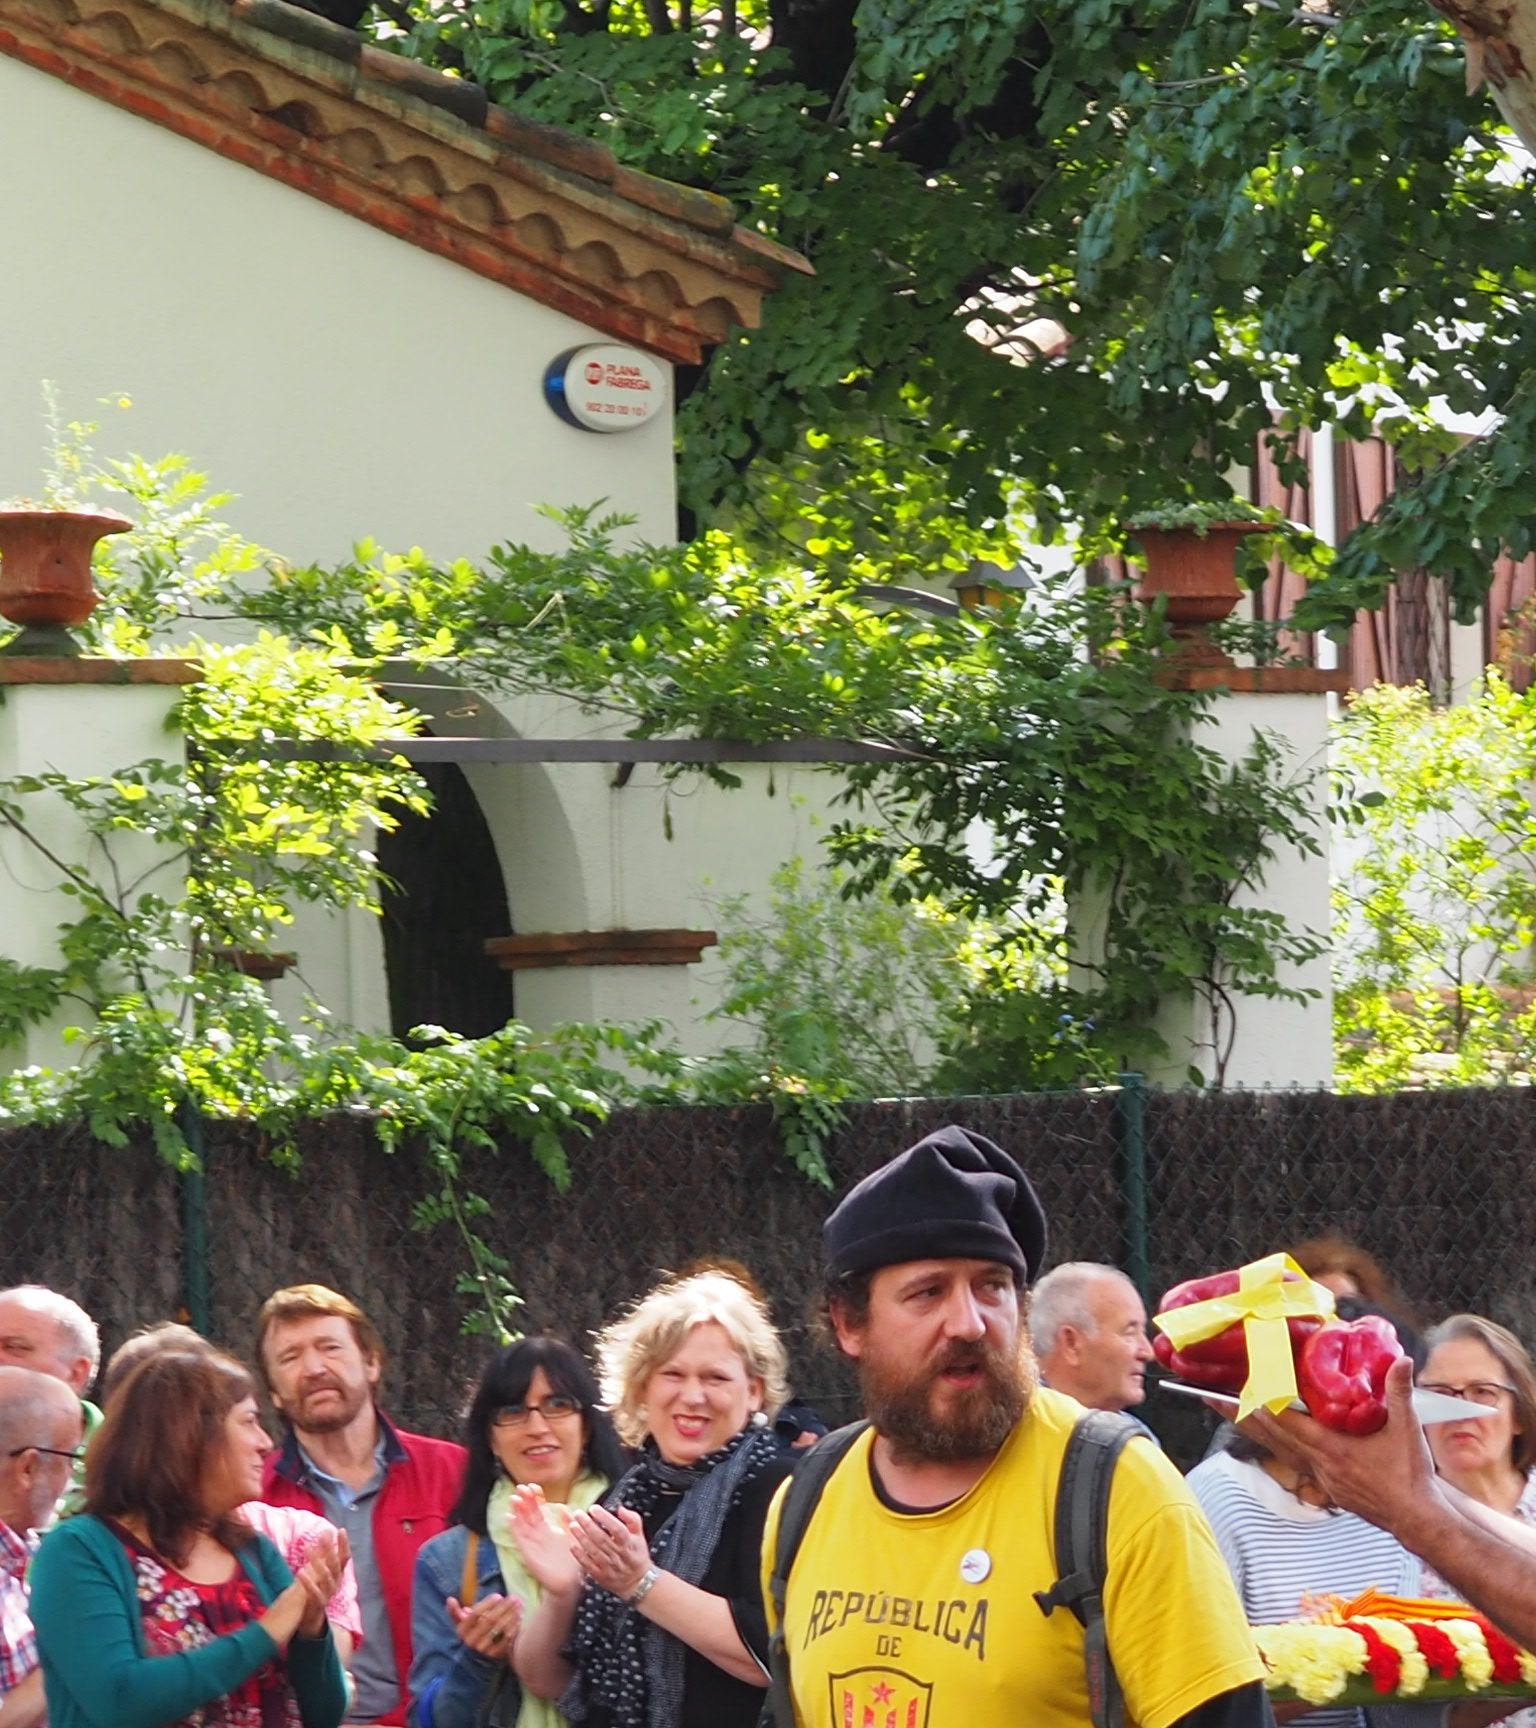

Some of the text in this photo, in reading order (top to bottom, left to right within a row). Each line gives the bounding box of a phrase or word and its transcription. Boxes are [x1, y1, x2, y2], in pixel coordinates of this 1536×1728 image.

[607, 364, 640, 376] PLANA
[803, 1590, 988, 1661] REPÚBLICA
[875, 1634, 903, 1658] DE
